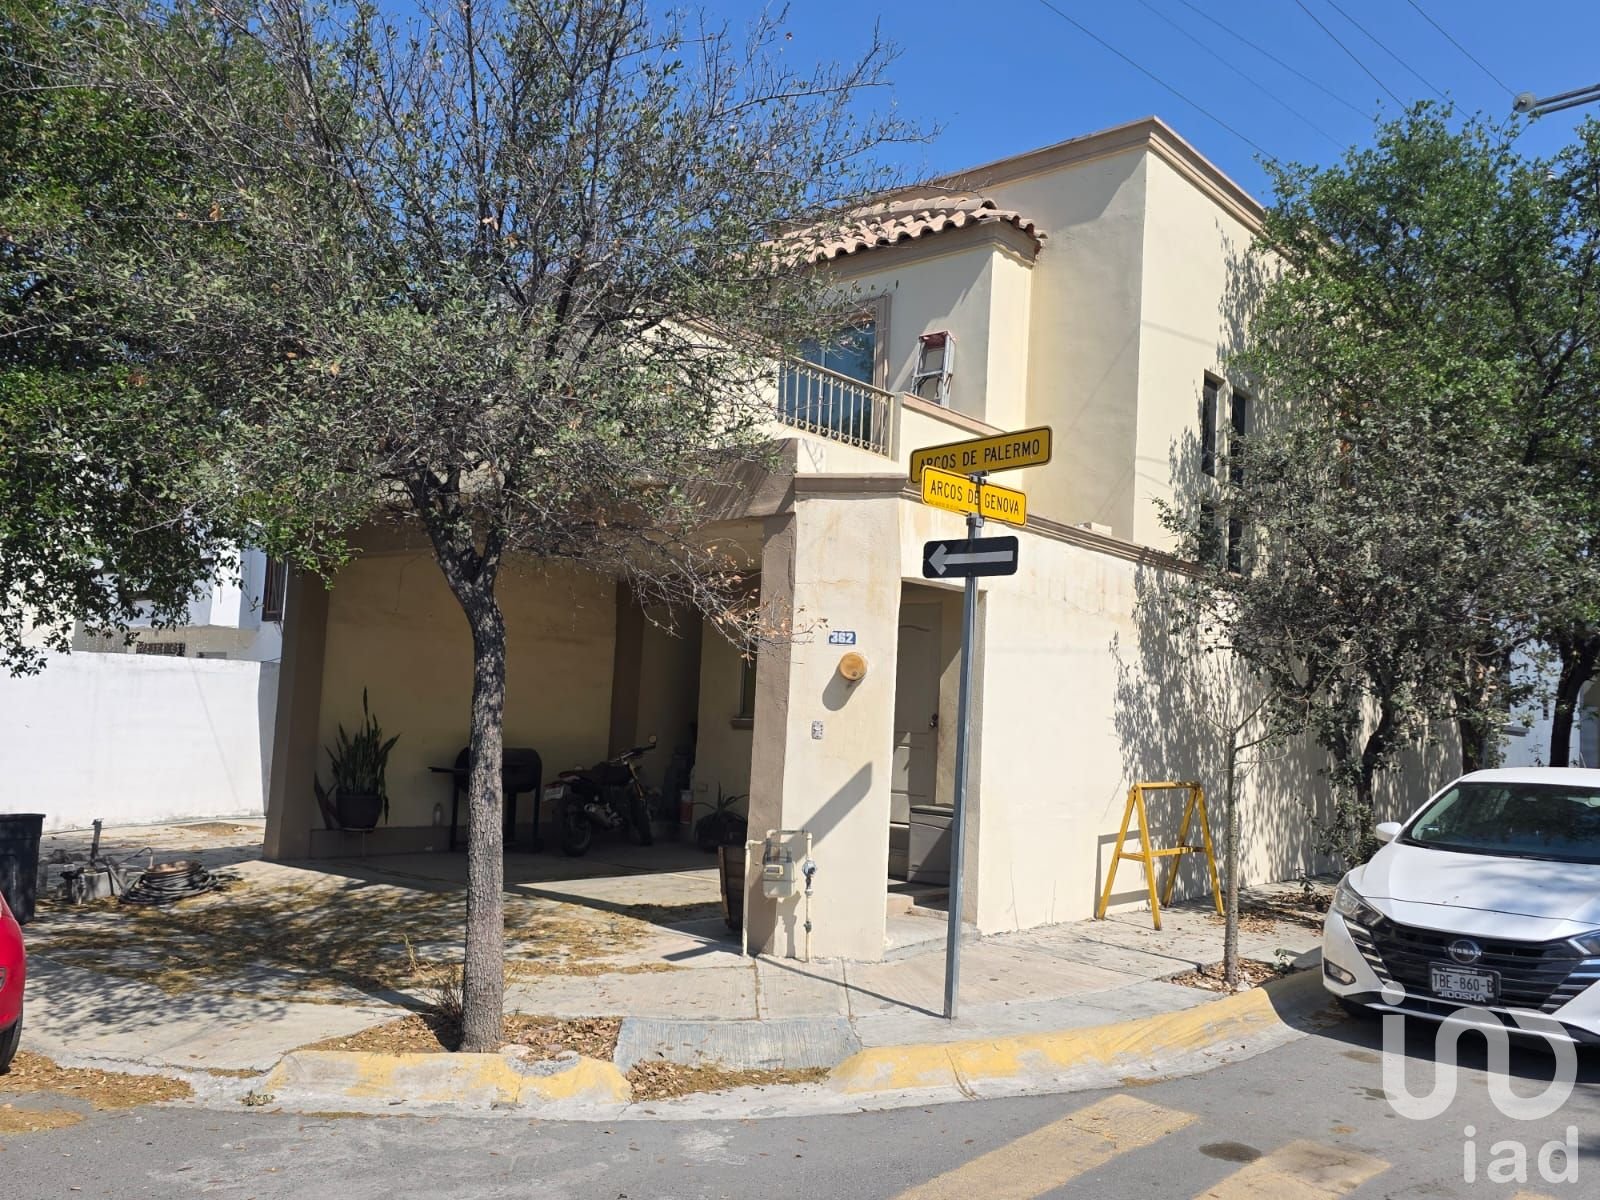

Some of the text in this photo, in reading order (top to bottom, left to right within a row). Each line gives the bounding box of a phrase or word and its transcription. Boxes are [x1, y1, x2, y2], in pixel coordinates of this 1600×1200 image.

[962, 449, 977, 467] DE
[984, 439, 1040, 463] PALERMO
[930, 479, 963, 502] ARCOS
[967, 488, 980, 506] DE
[984, 492, 1020, 515] GENOVA
[830, 632, 854, 644] 362
[1448, 946, 1482, 958] NISSAN
[1437, 990, 1486, 1003] JIDOSHA
